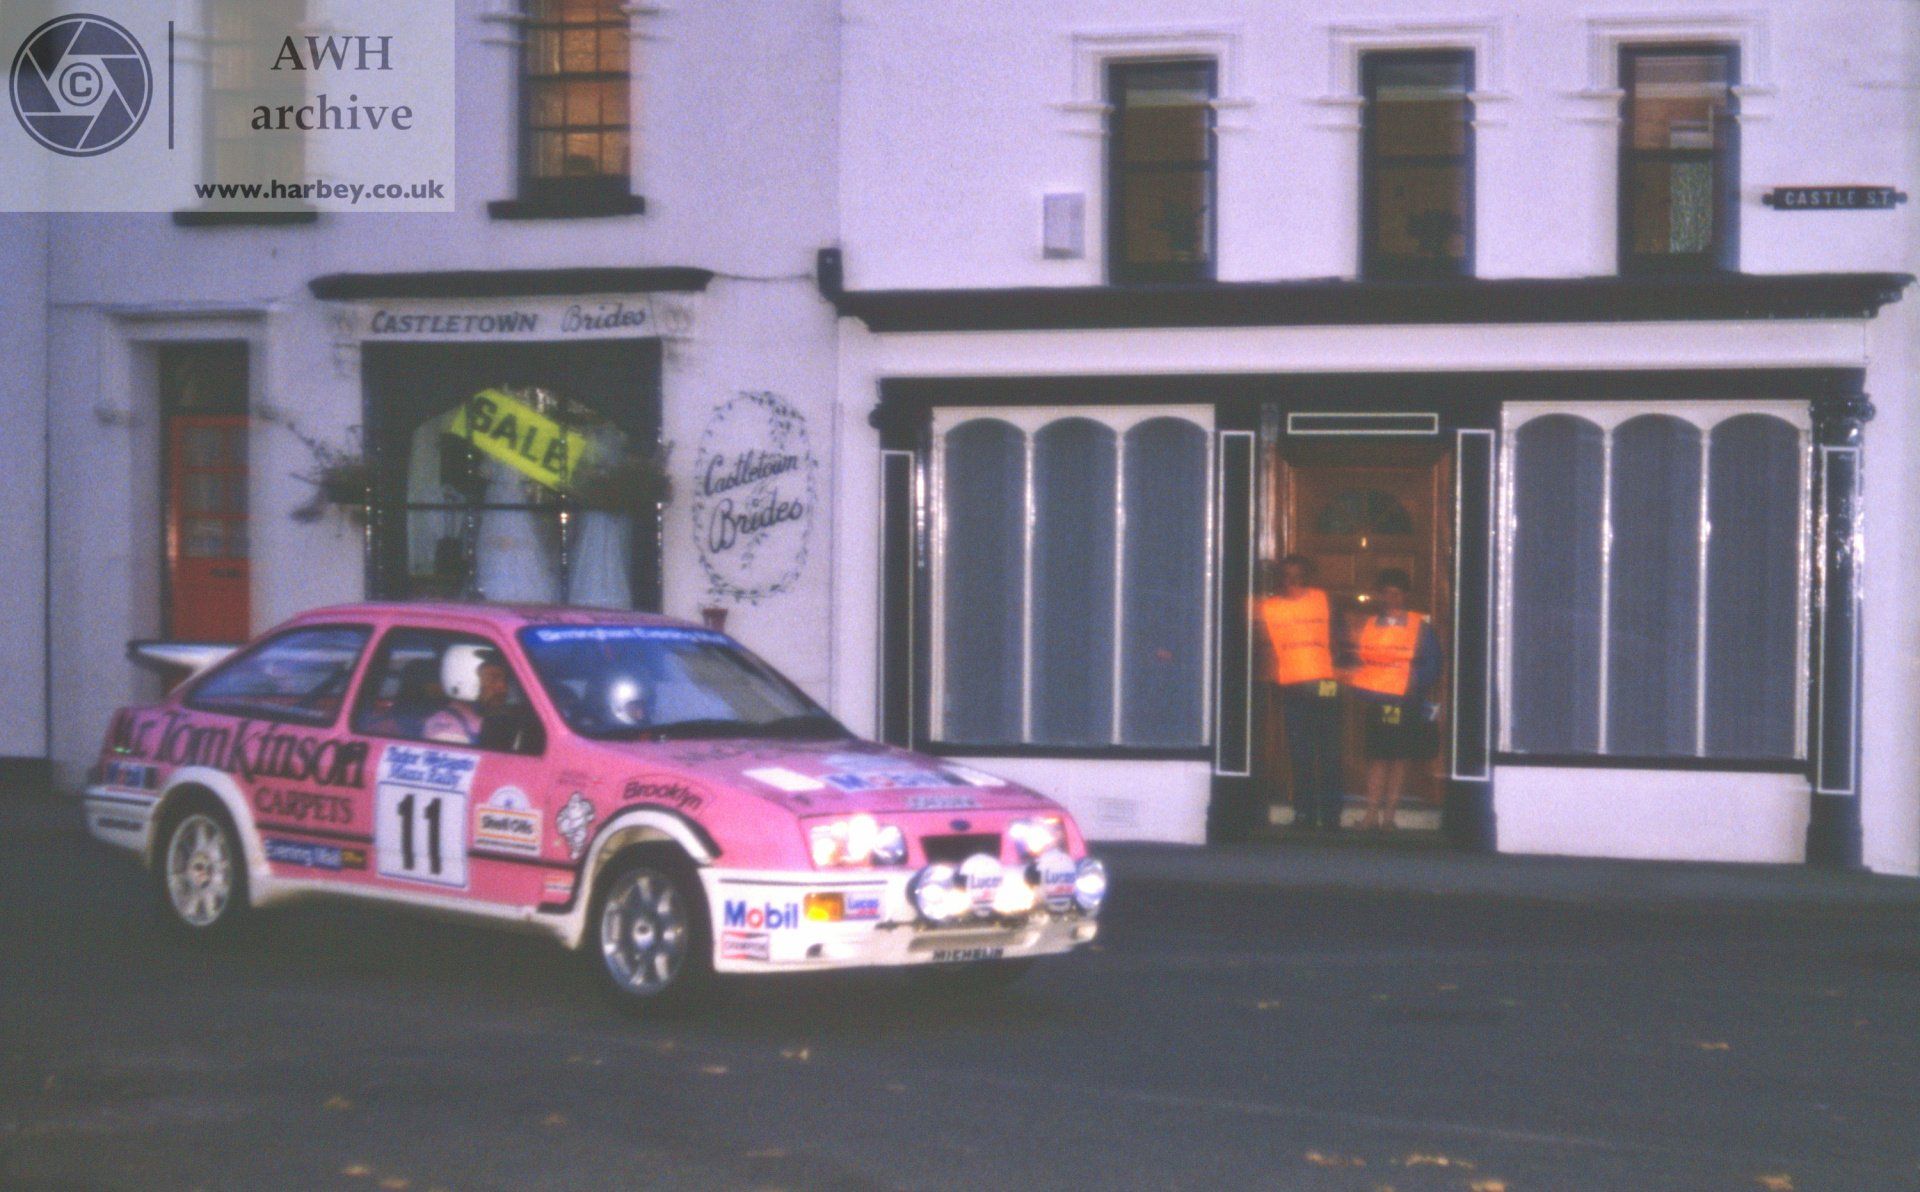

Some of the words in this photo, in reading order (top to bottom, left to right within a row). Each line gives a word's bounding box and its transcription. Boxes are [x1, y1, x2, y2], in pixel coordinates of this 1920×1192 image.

[1784, 190, 1856, 205] CASTLE
[371, 310, 538, 333] CASTLETOWN
[561, 302, 646, 332] Brides
[469, 396, 567, 475] SALE
[704, 450, 797, 496] Castletown
[709, 487, 803, 553] Brides
[253, 786, 356, 823] CARPETS
[622, 781, 703, 810] Brooklyn
[397, 793, 442, 875] 11
[724, 900, 799, 929] Mobil
